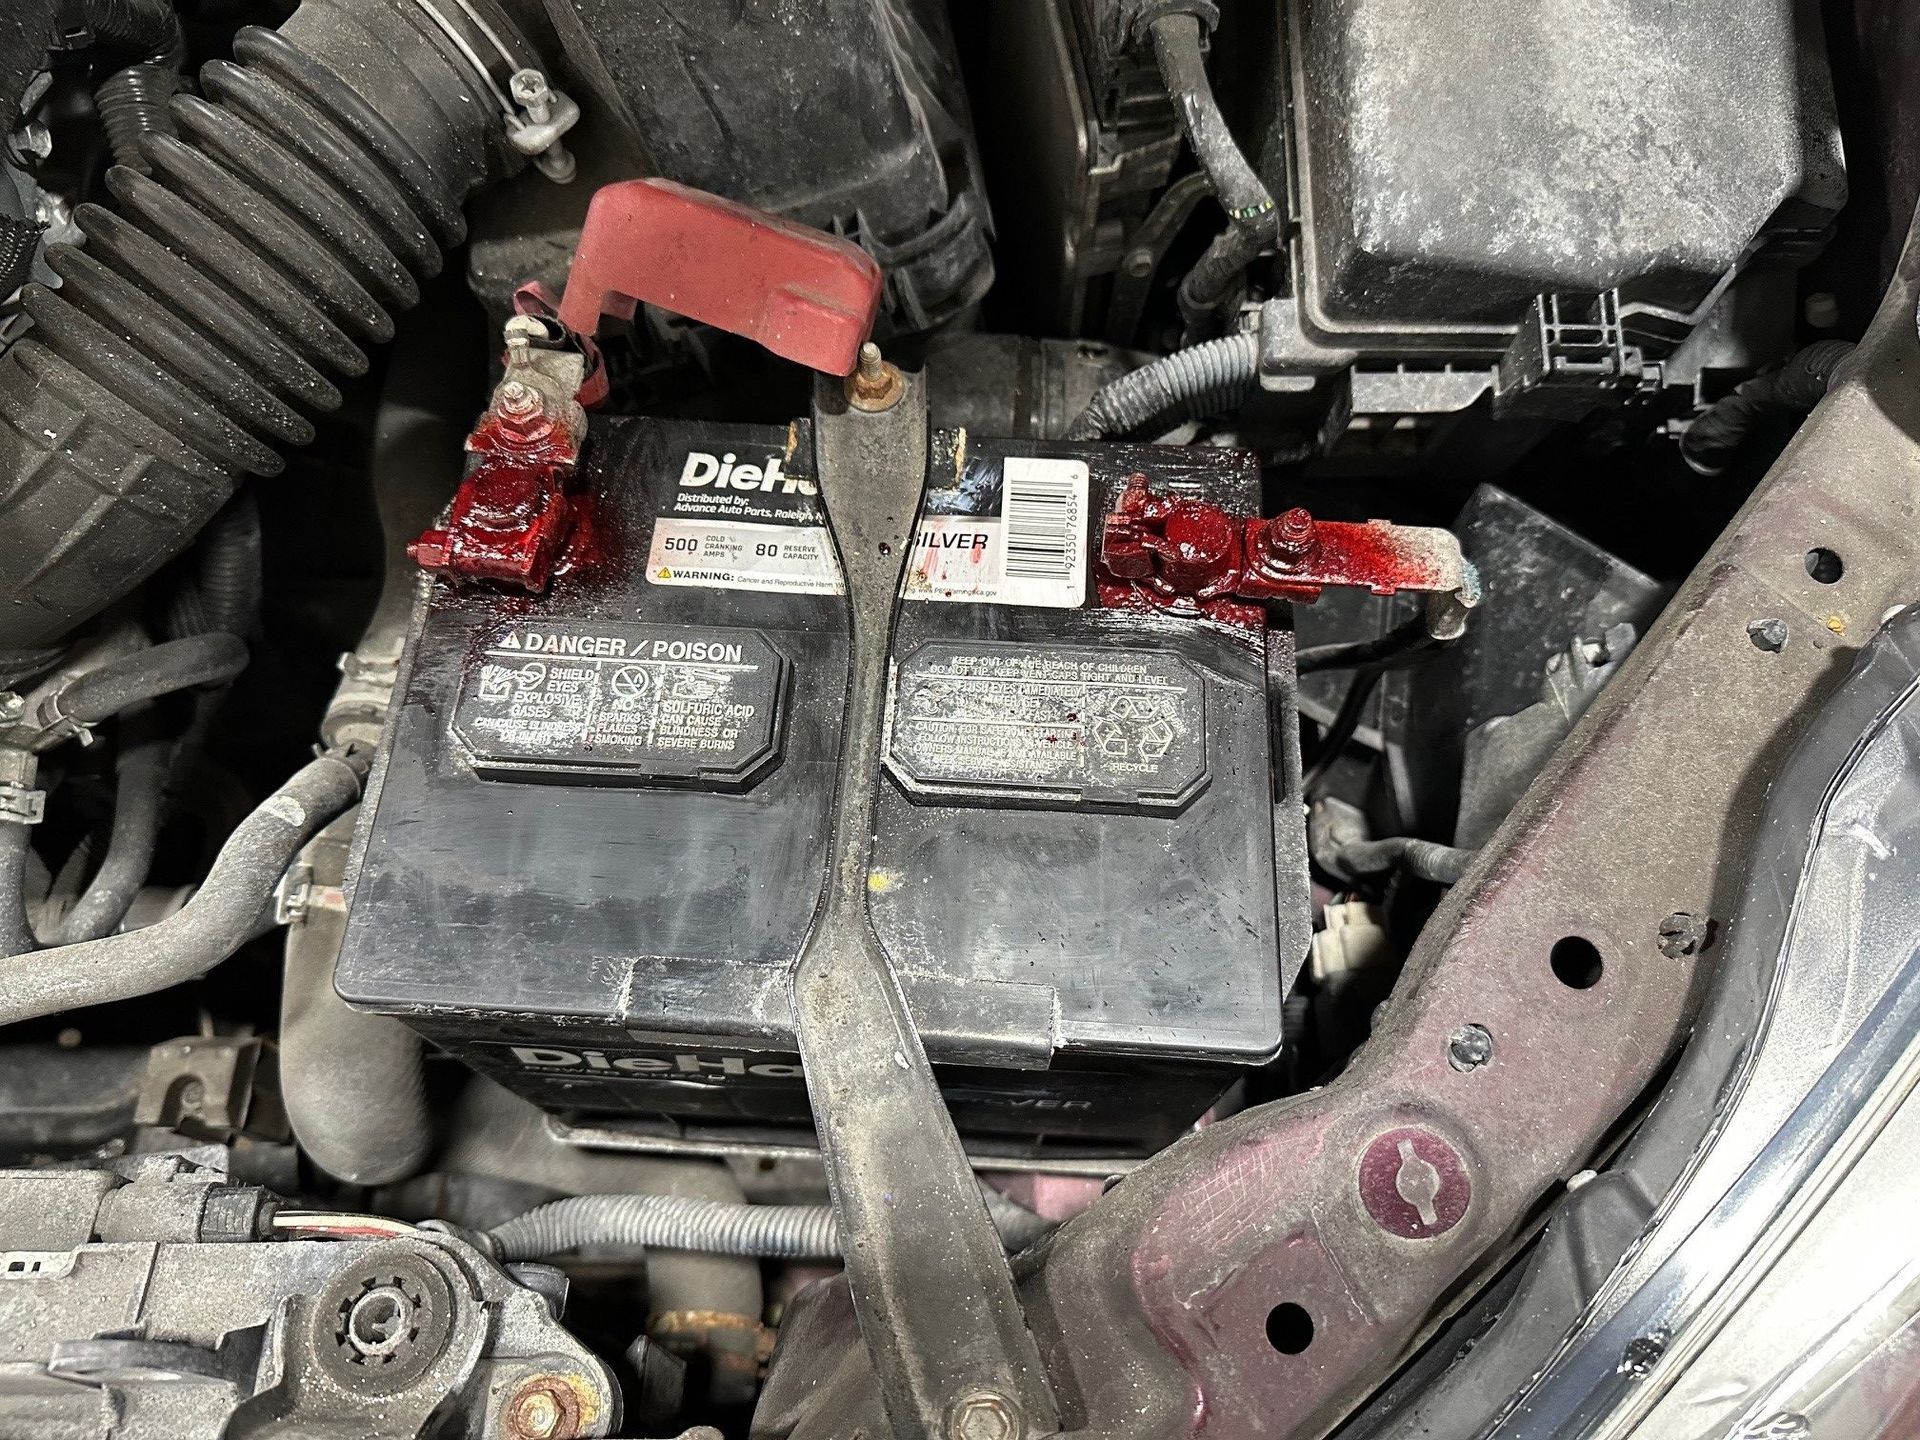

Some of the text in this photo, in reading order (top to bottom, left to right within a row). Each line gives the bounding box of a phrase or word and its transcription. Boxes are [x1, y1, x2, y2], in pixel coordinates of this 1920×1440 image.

[677, 493, 749, 507] Distributed by:
[674, 503, 716, 513] Advance
[717, 504, 742, 514] Auto
[744, 506, 772, 518] Parts,
[1066, 494, 1077, 528] 76854
[665, 537, 698, 552] 500
[704, 543, 743, 551] CRANKING
[755, 543, 778, 557] 80
[784, 545, 816, 553] RESERVE
[1065, 534, 1077, 569] 92350
[782, 552, 819, 560] CAPACITY
[673, 570, 735, 582] WARNING:
[737, 575, 760, 584] Cancer
[761, 577, 773, 585] and
[775, 579, 814, 588] Reproductive
[524, 632, 627, 657] DANGER
[652, 640, 742, 662] POISON
[952, 656, 977, 666] KEEP
[981, 656, 1003, 667] OUT
[1045, 660, 1079, 670] REACH
[1081, 661, 1095, 672] OF
[1097, 662, 1147, 674] CHILDREN
[549, 667, 594, 681] SHIELD
[994, 667, 1019, 677] KEEP
[1051, 670, 1078, 681] CAPS
[1081, 672, 1113, 682] TIGHT
[1115, 674, 1138, 684] AND
[547, 681, 579, 692] EYES
[513, 691, 582, 706] EXPLOSIVE
[612, 699, 635, 711] NO
[511, 704, 552, 718] GASES
[663, 700, 755, 717] SULFURIC ACID
[600, 712, 642, 724] SPARKS
[660, 715, 722, 727] CAN CAUSE
[596, 723, 638, 735] FLAMES
[659, 725, 739, 739] BLINDNESS OR
[593, 733, 642, 746] SMOKING
[657, 736, 735, 751] SEVERE BURNS
[1112, 762, 1159, 773] RECYCLE
[510, 1047, 804, 1077] DieHa
